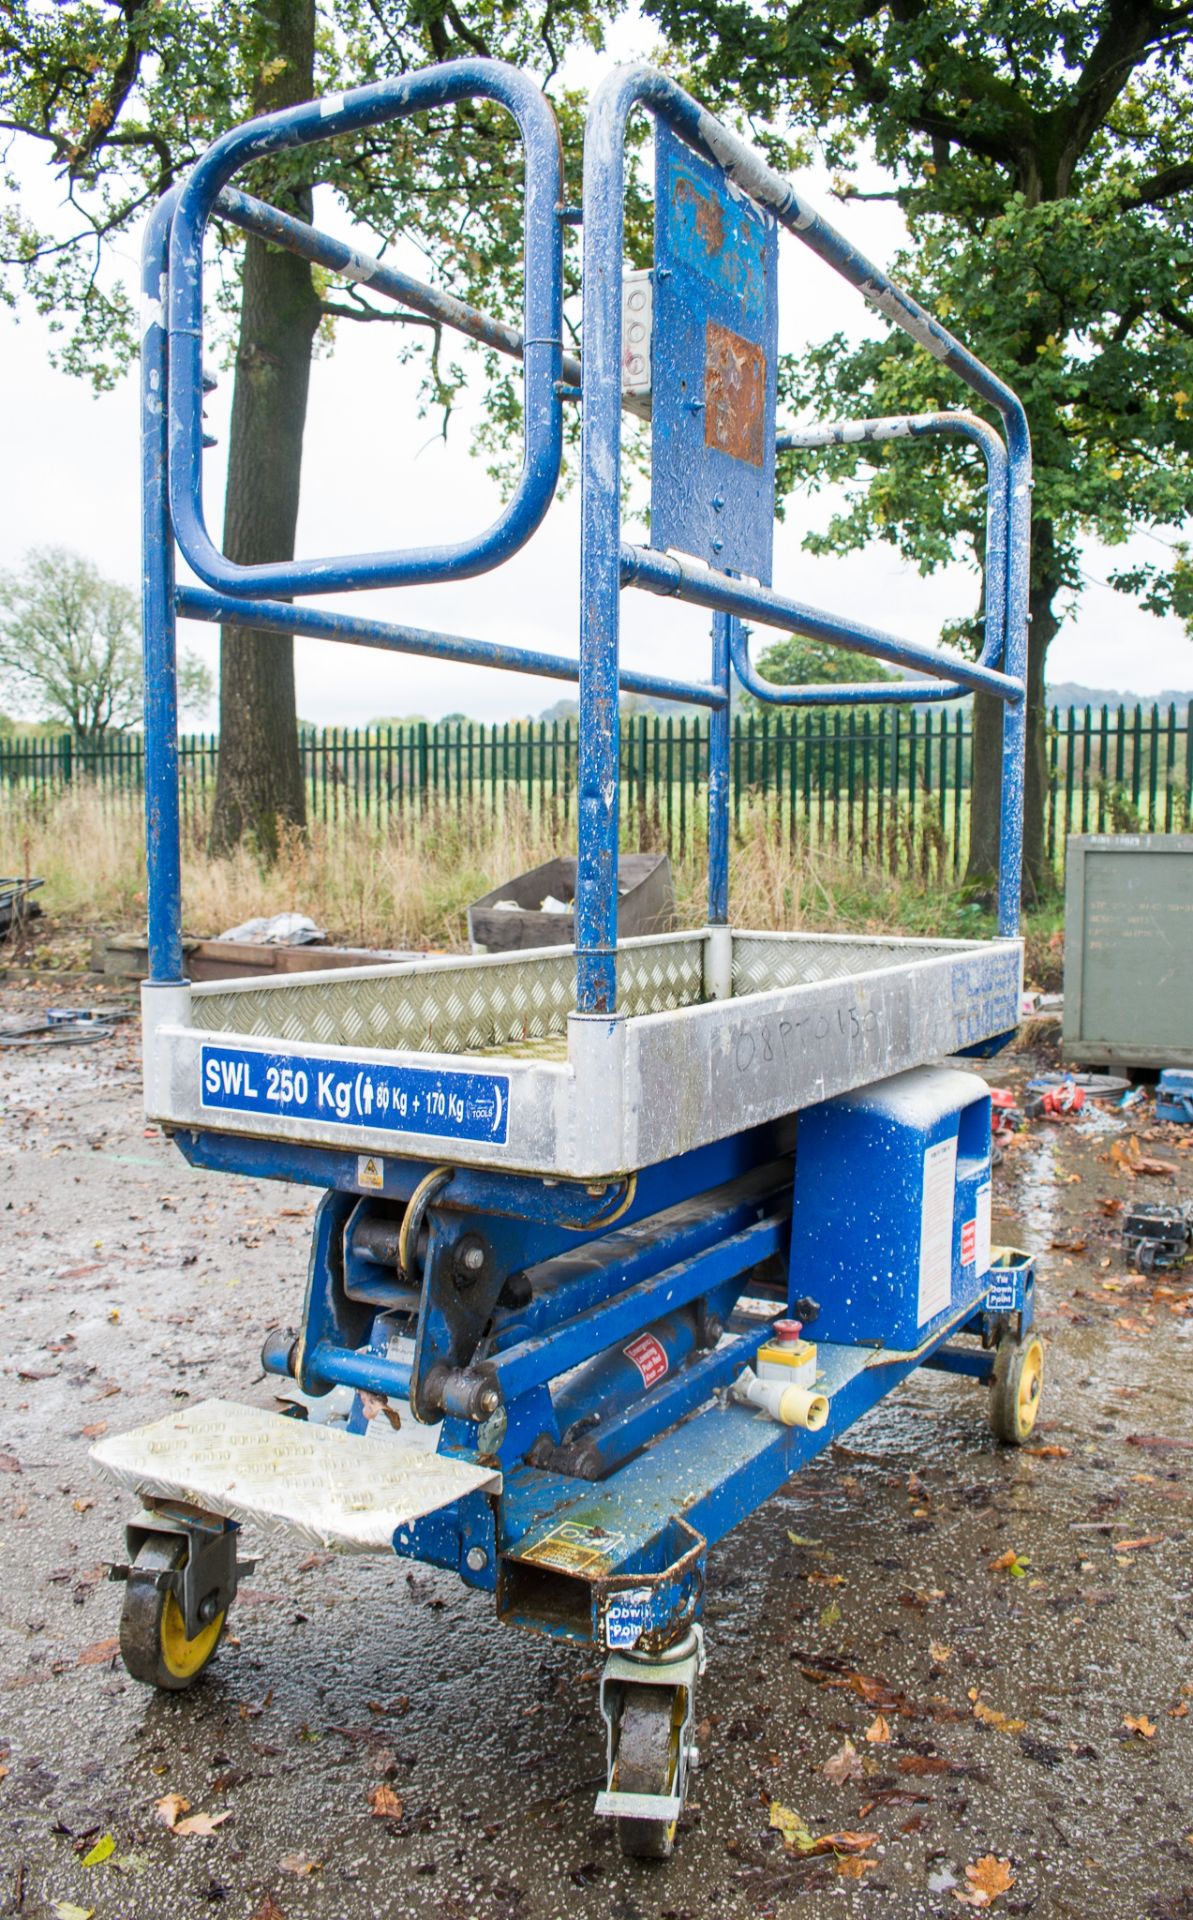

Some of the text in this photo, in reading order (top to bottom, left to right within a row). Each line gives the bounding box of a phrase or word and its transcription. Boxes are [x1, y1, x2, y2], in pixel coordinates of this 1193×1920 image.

[205, 1058, 258, 1098] SWL
[266, 1067, 308, 1105] 250
[376, 1085, 390, 1109] 80
[392, 1087, 408, 1117] Kg
[426, 1091, 445, 1116] 170
[448, 1093, 464, 1123] Kg
